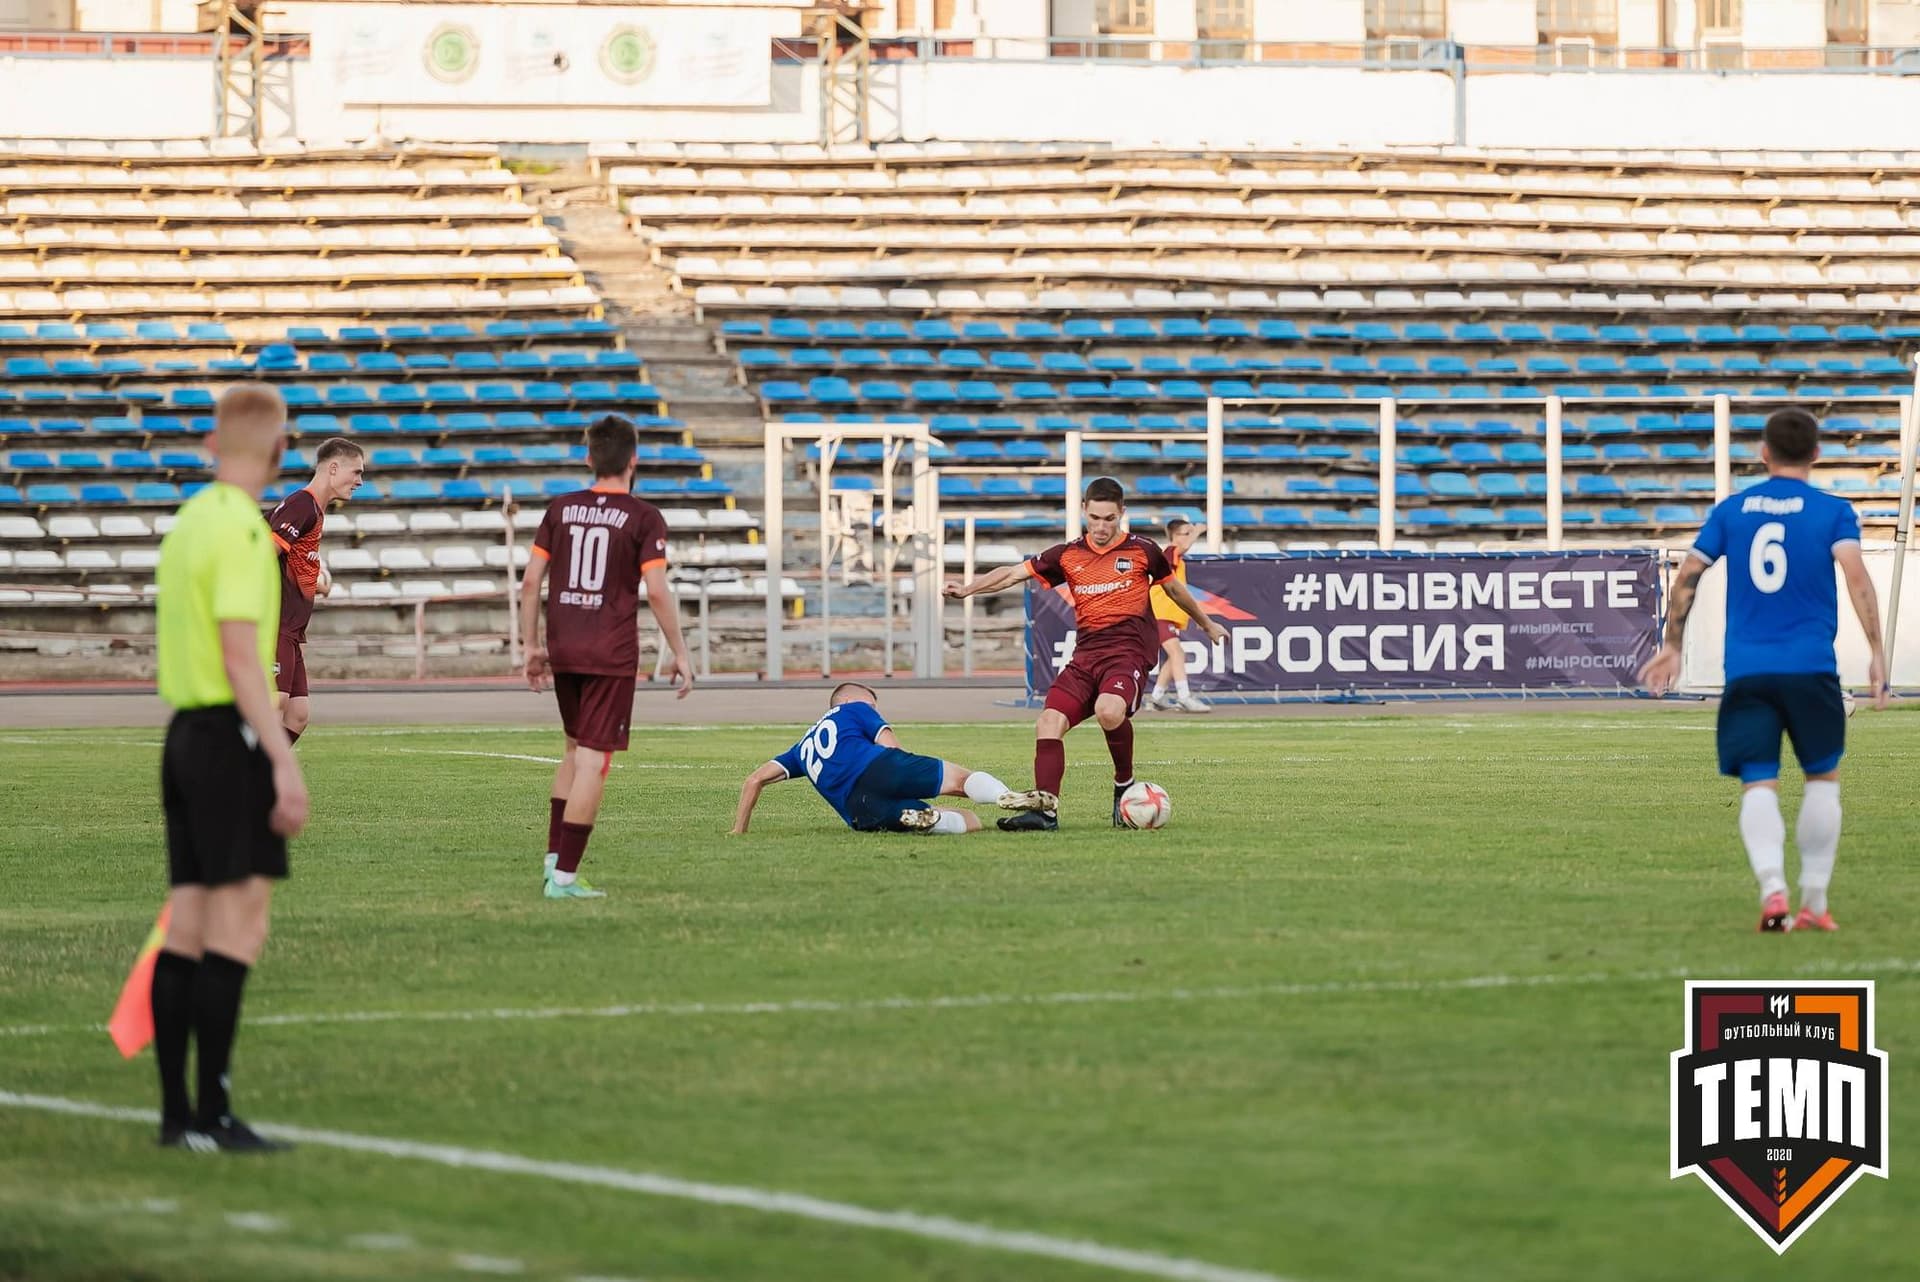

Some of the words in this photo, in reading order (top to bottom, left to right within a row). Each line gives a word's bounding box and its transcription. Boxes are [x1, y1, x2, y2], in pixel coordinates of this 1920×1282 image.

[562, 505, 629, 529] АПАЛЬКИН
[569, 526, 610, 591] 10
[1750, 522, 1788, 594] 6
[1283, 571, 1638, 611] #МЫВМЕСТЕ
[1052, 624, 1504, 674] #ЫРОССИЯ
[1510, 623, 1594, 635] #МЫВМЕСТЕ
[1525, 655, 1637, 671] #МЫРОССИЯ
[800, 718, 838, 784] 20
